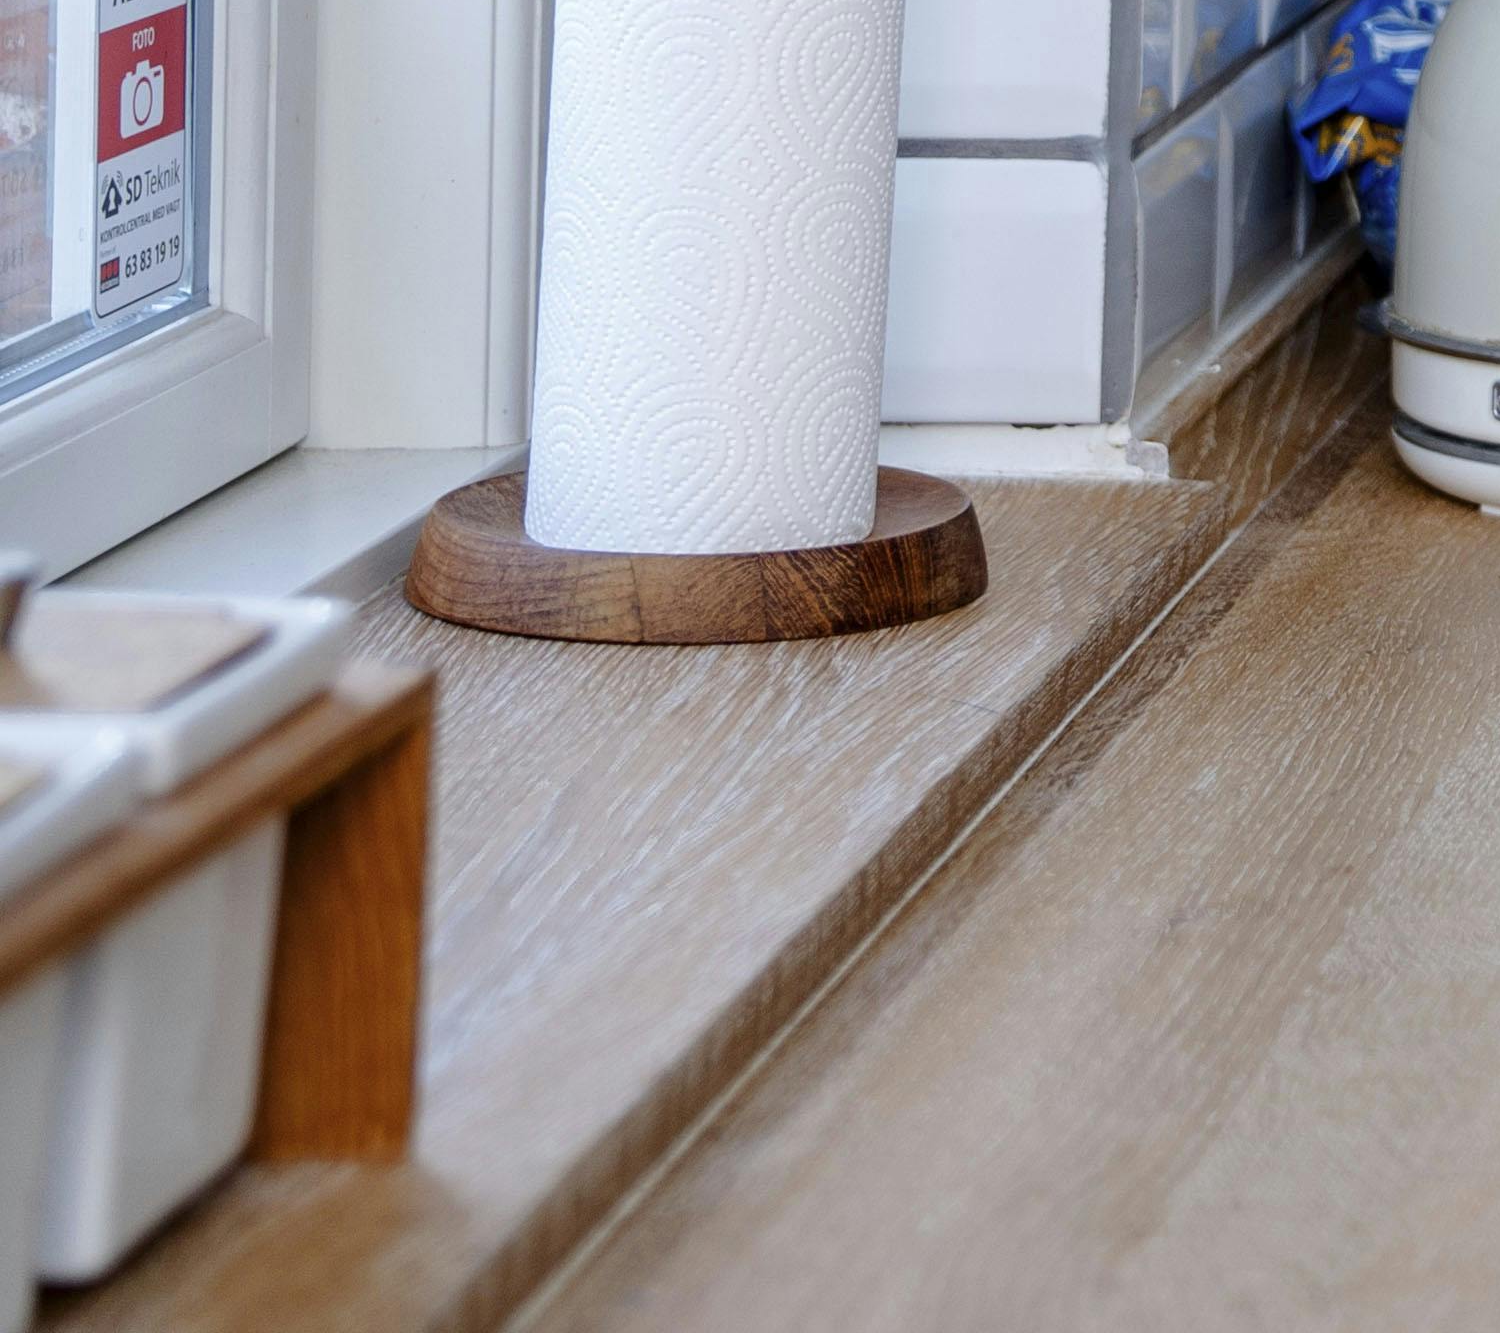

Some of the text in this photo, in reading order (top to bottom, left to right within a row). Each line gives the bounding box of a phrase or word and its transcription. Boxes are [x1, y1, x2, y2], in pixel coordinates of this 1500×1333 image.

[132, 26, 155, 51] FOTO
[126, 158, 181, 205] SD Teknik
[100, 198, 181, 244] KONTROLCENTRAL MED VAGT
[125, 253, 138, 278] 63
[140, 247, 152, 271] 83
[155, 241, 166, 264] 19
[169, 235, 180, 258] 19
